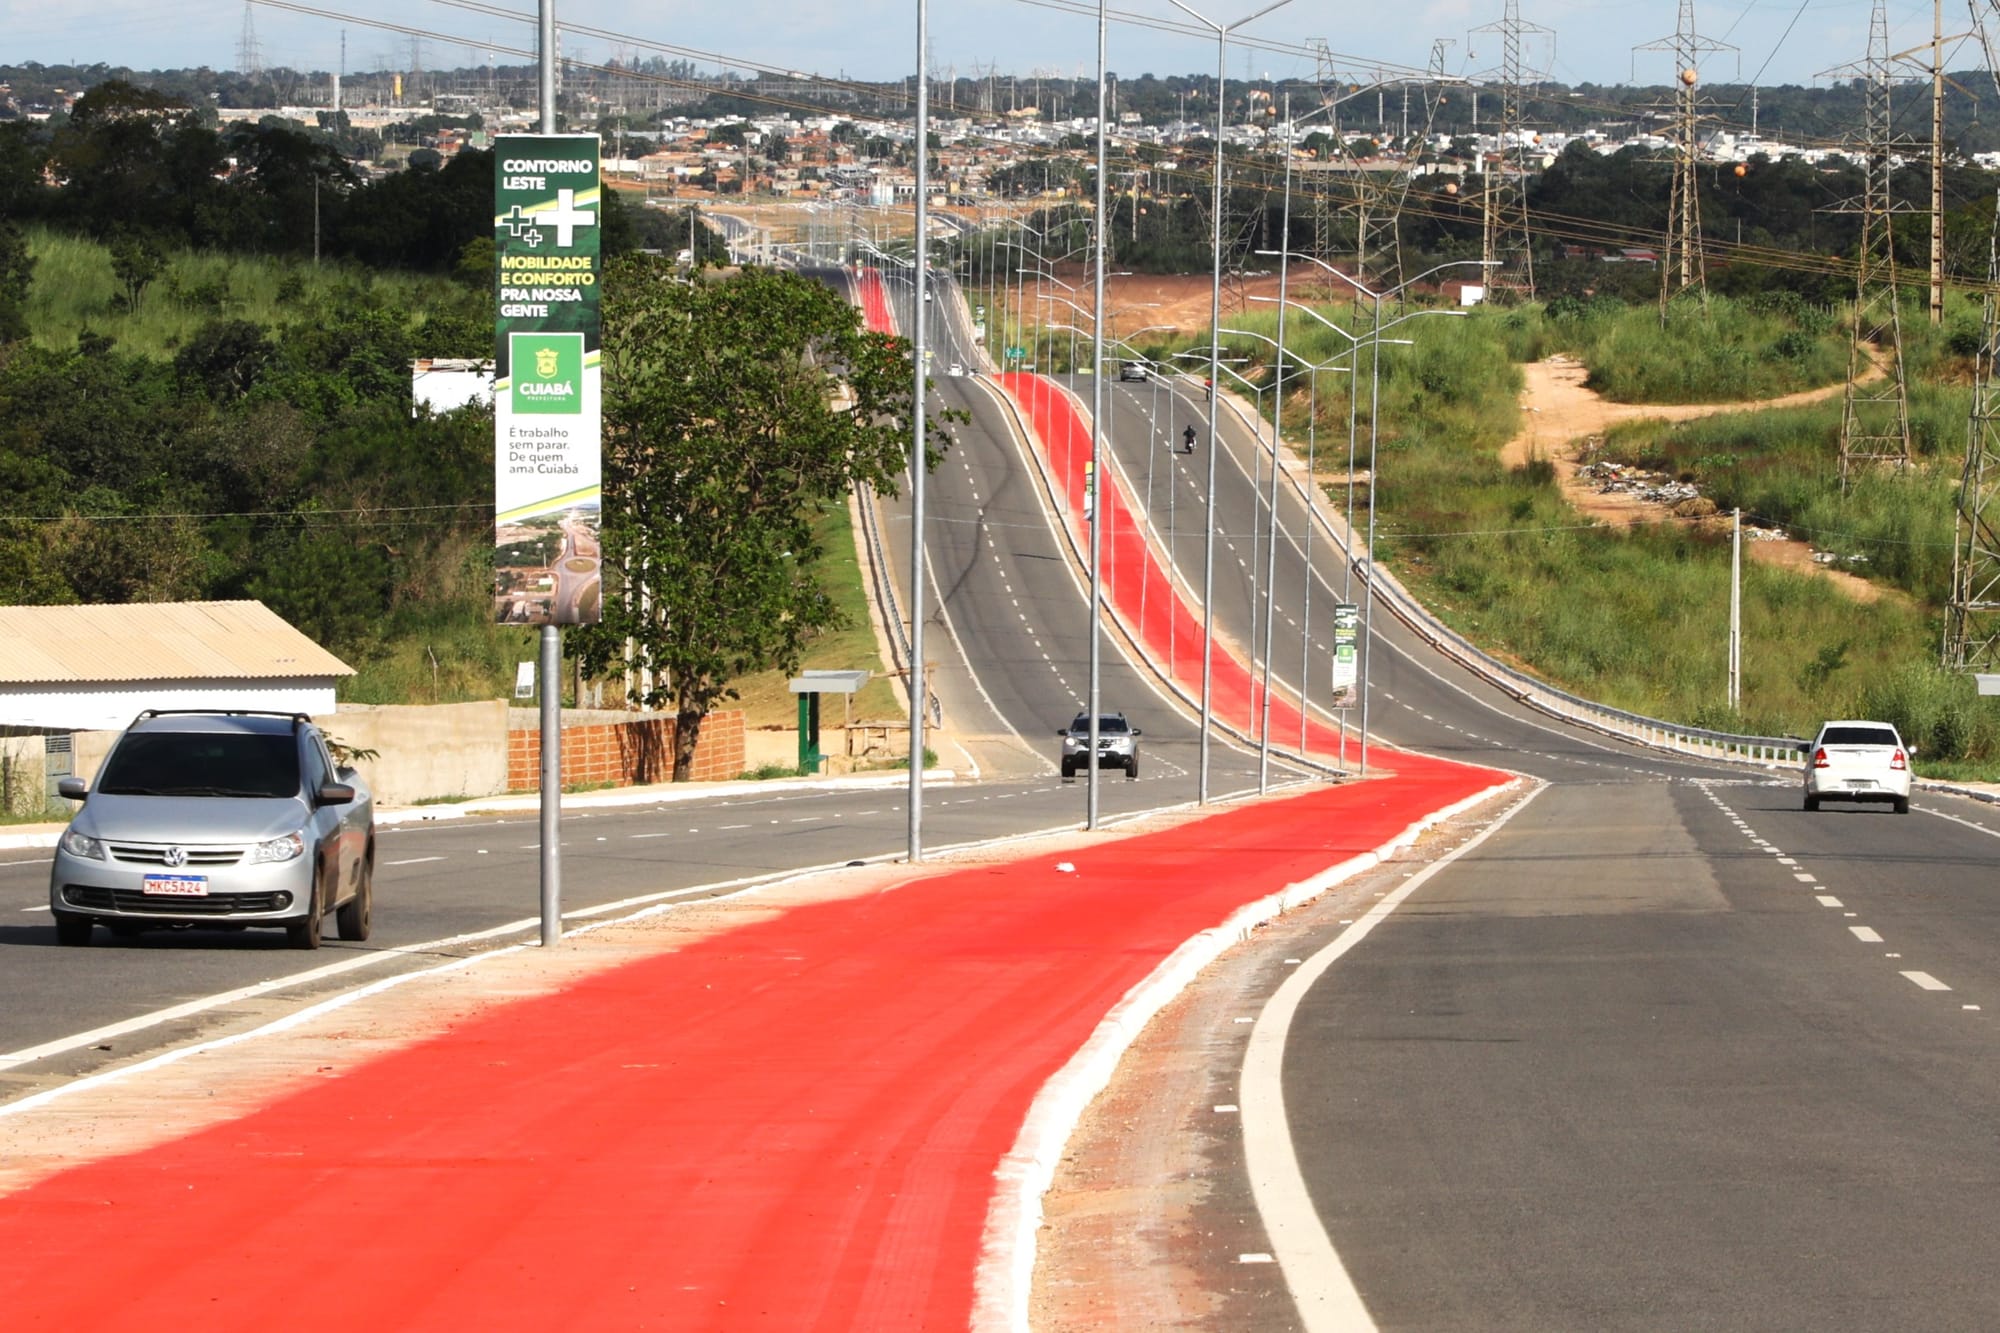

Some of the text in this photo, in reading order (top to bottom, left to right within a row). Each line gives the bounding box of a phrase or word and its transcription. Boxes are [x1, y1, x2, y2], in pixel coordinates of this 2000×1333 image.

[503, 159, 593, 174] CONTORNO
[503, 176, 546, 190] LESTE
[501, 256, 592, 269] MOBILIDADE
[501, 272, 595, 285] E CONFORTO
[500, 288, 582, 302] PRA NOSSA
[500, 304, 548, 317] GENTE
[519, 380, 574, 396] CUIABÁ
[509, 424, 569, 438] É trabalho
[508, 442, 570, 453] sem parar.
[509, 451, 563, 464] De quem
[508, 463, 579, 474] ama Cuiabá
